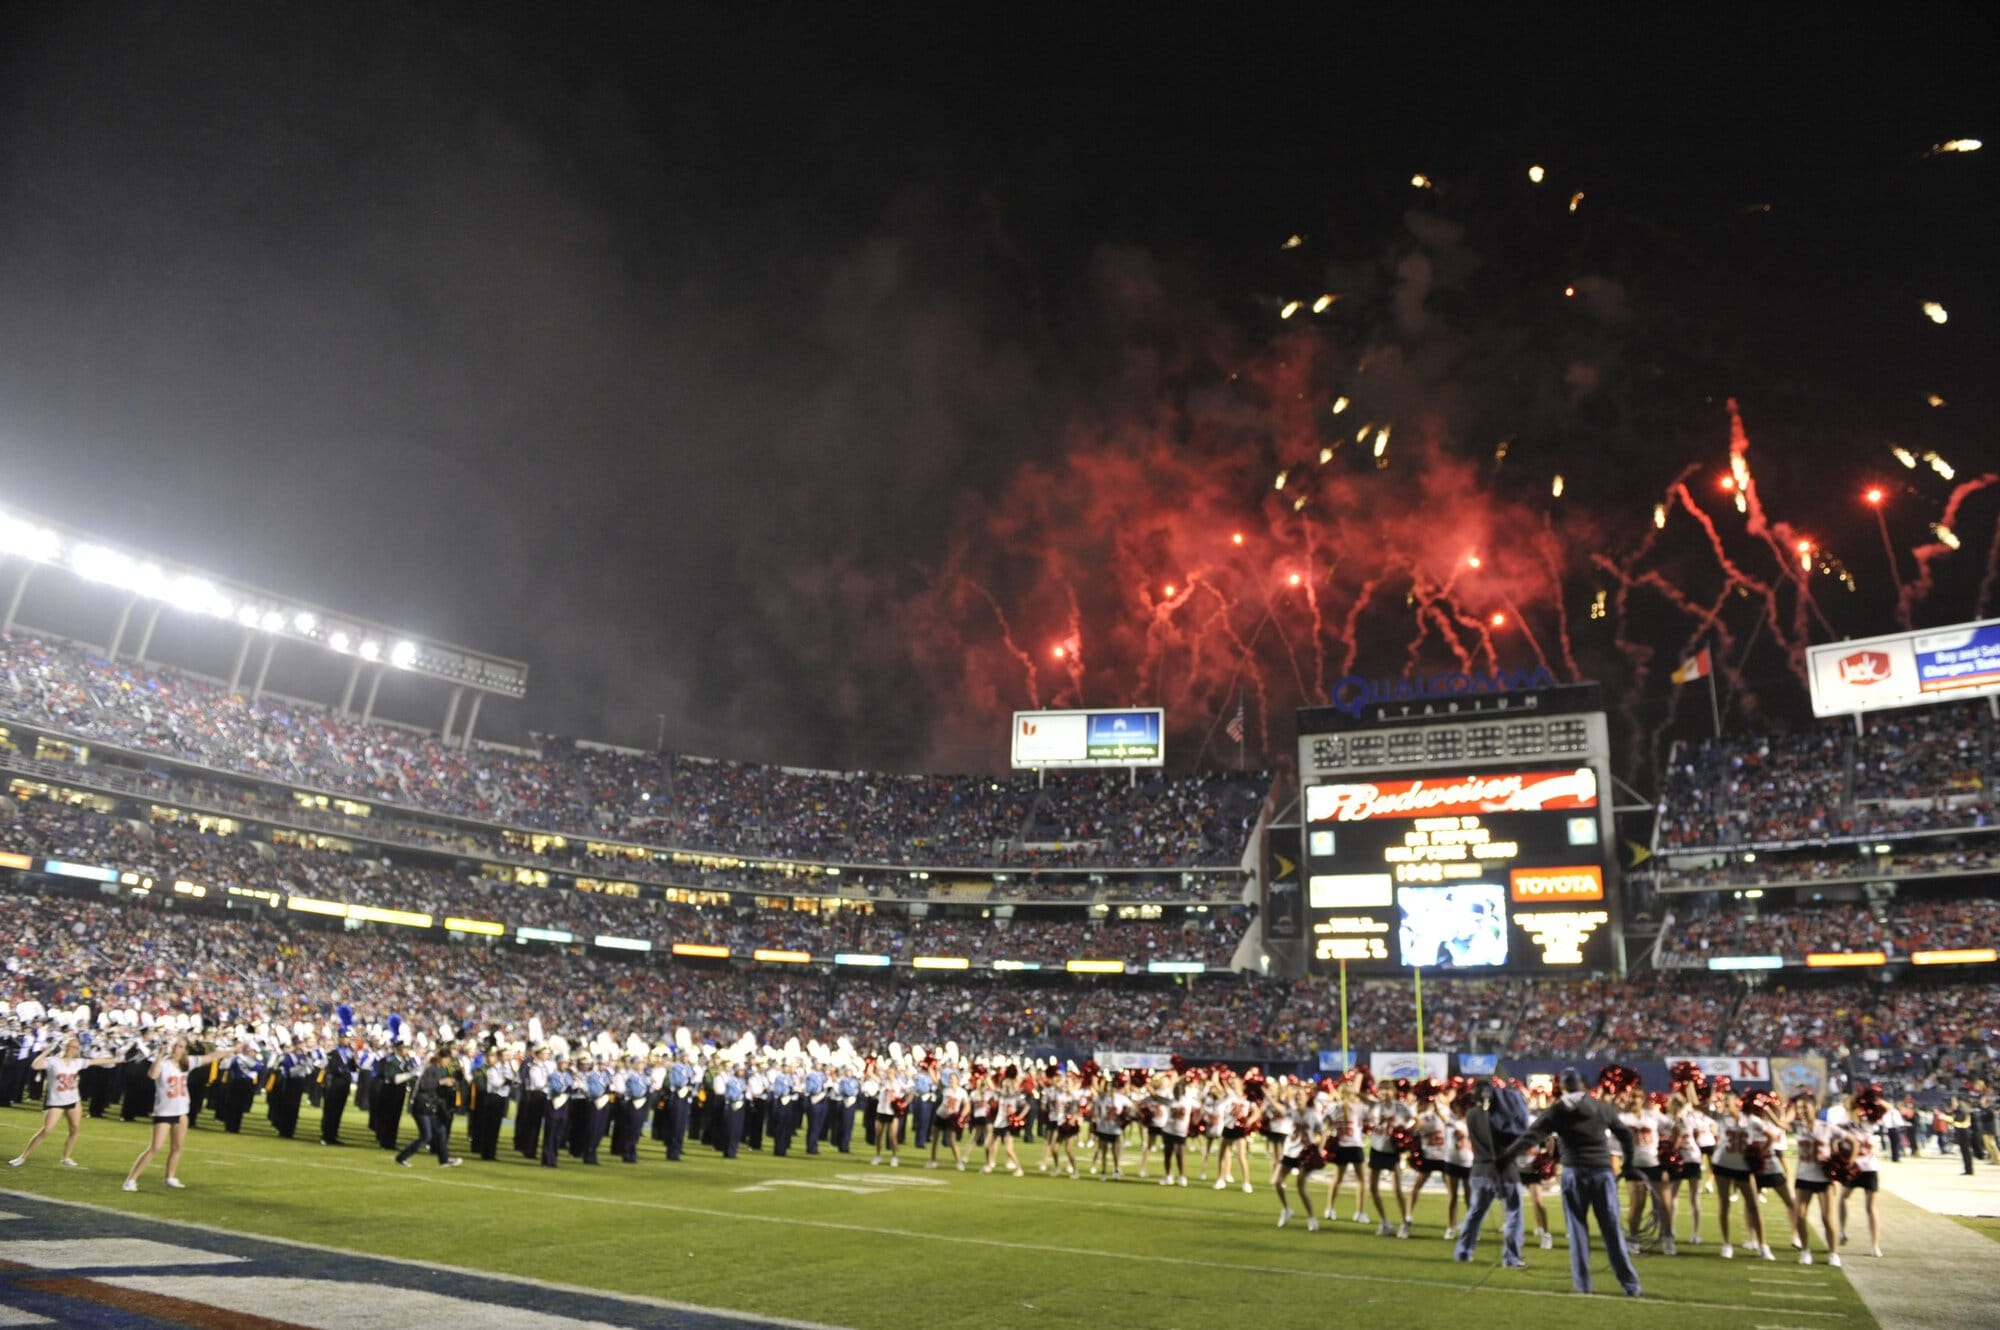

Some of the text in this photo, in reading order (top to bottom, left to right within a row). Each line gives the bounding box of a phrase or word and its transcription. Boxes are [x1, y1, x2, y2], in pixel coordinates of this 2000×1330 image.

[1331, 667, 1553, 719] QUALCOMM
[1377, 695, 1539, 720] STADIUM
[1337, 776, 1522, 821] Budweiser
[1515, 875, 1598, 895] TOYOTA
[1738, 1060, 1760, 1078] N
